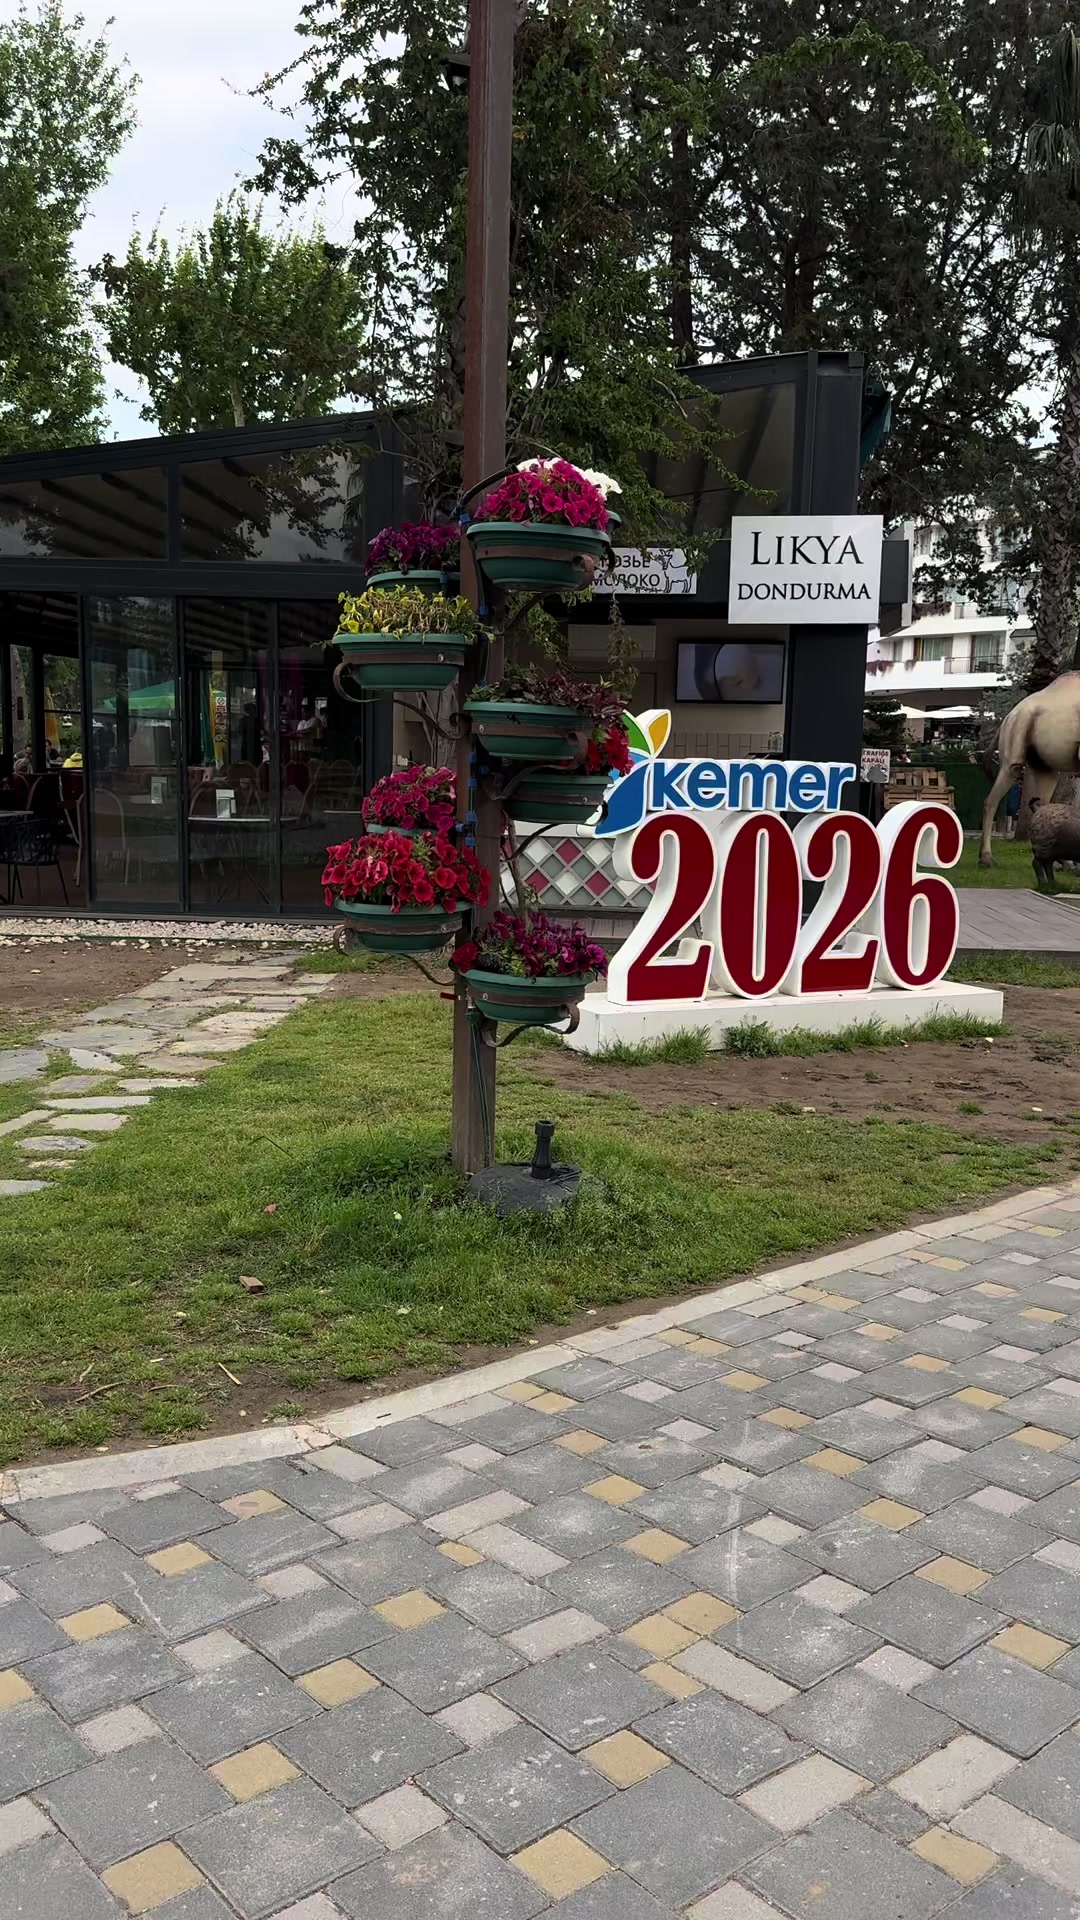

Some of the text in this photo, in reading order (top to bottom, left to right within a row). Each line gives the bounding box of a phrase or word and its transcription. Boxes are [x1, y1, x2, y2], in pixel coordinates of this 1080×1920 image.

[750, 531, 864, 565] LIKYA
[737, 582, 872, 600] DONDURMA
[624, 805, 962, 1003] 2026
